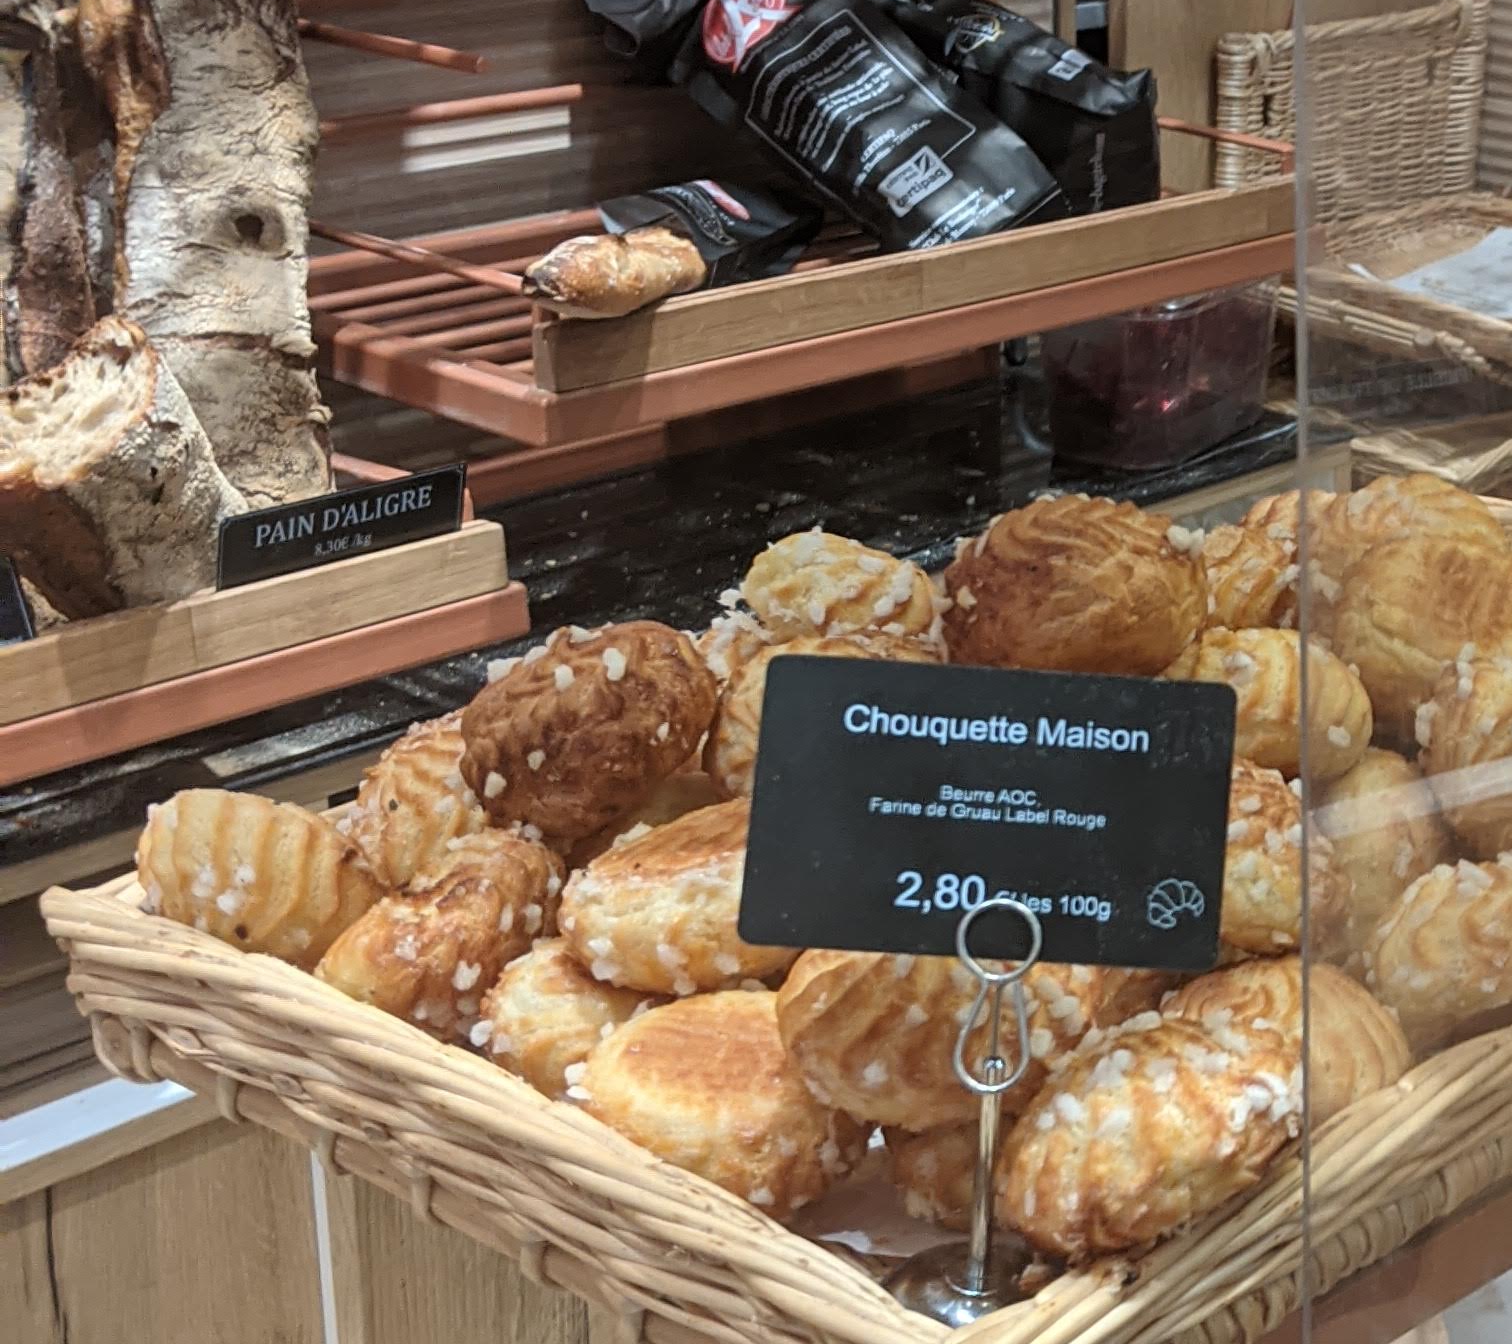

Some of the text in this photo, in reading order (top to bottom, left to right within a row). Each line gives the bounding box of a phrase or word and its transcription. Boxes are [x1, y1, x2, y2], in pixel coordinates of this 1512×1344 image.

[255, 484, 433, 548] PAIN D'ALIGRE
[843, 702, 1150, 754] Chouquette Maison
[868, 797, 1107, 831] Farine de Gruau Label Rouge
[940, 785, 995, 805] Beurre
[894, 871, 986, 914] 2,80
[1059, 895, 1112, 921] 100g
